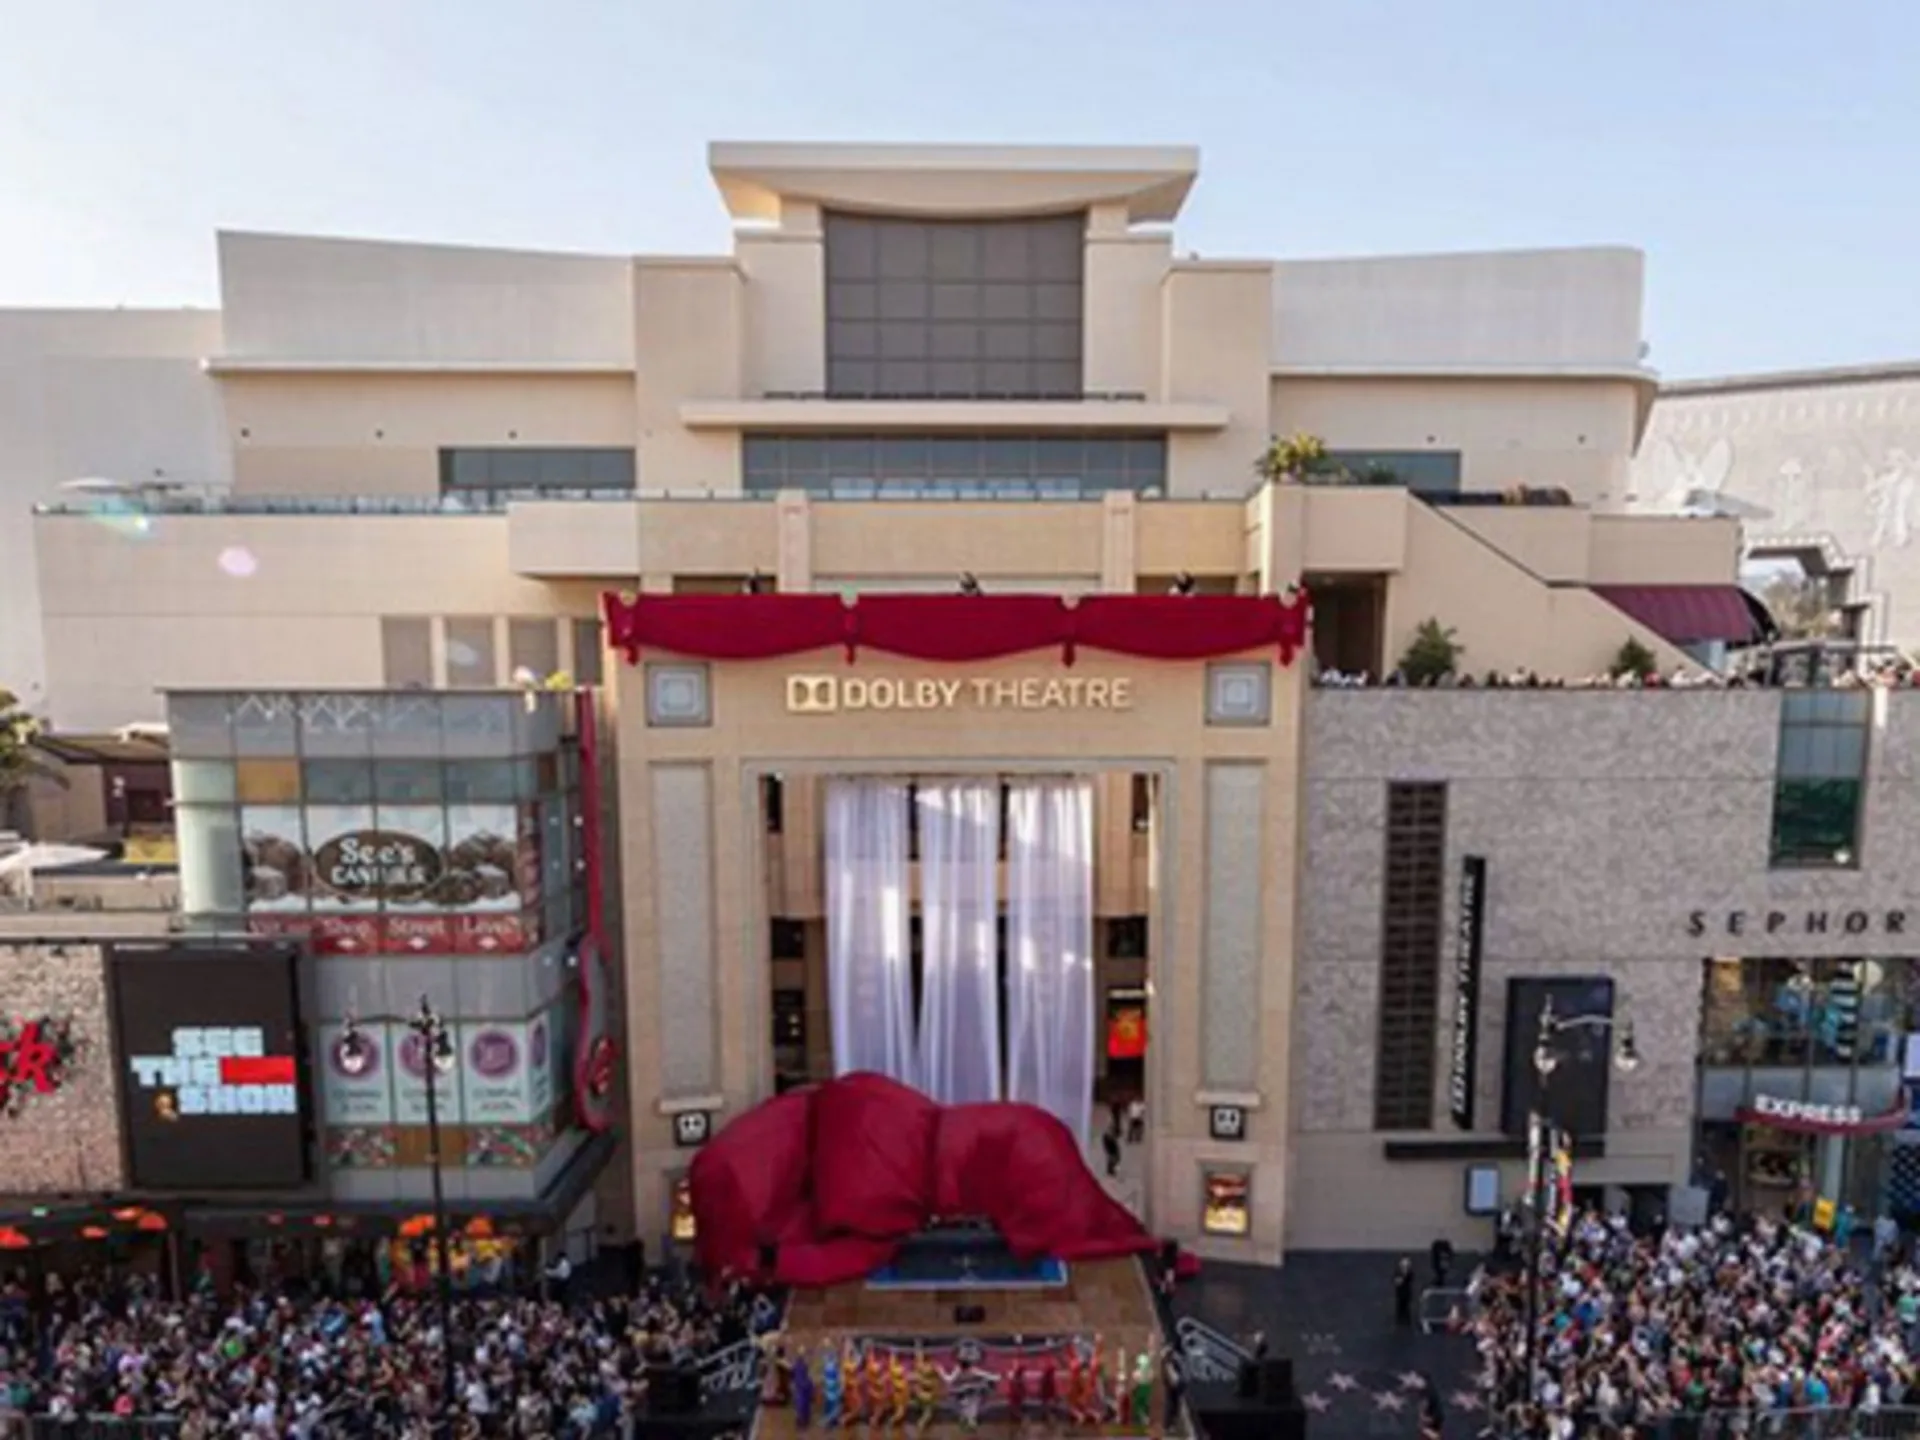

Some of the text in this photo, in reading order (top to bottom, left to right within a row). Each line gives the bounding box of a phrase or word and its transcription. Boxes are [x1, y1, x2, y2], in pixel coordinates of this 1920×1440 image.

[843, 678, 1132, 709] DOLBY THEATRE
[1685, 908, 1908, 939] SEPHOR
[178, 1084, 297, 1114] SHOW
[1755, 1093, 1862, 1126] EXPRESS
